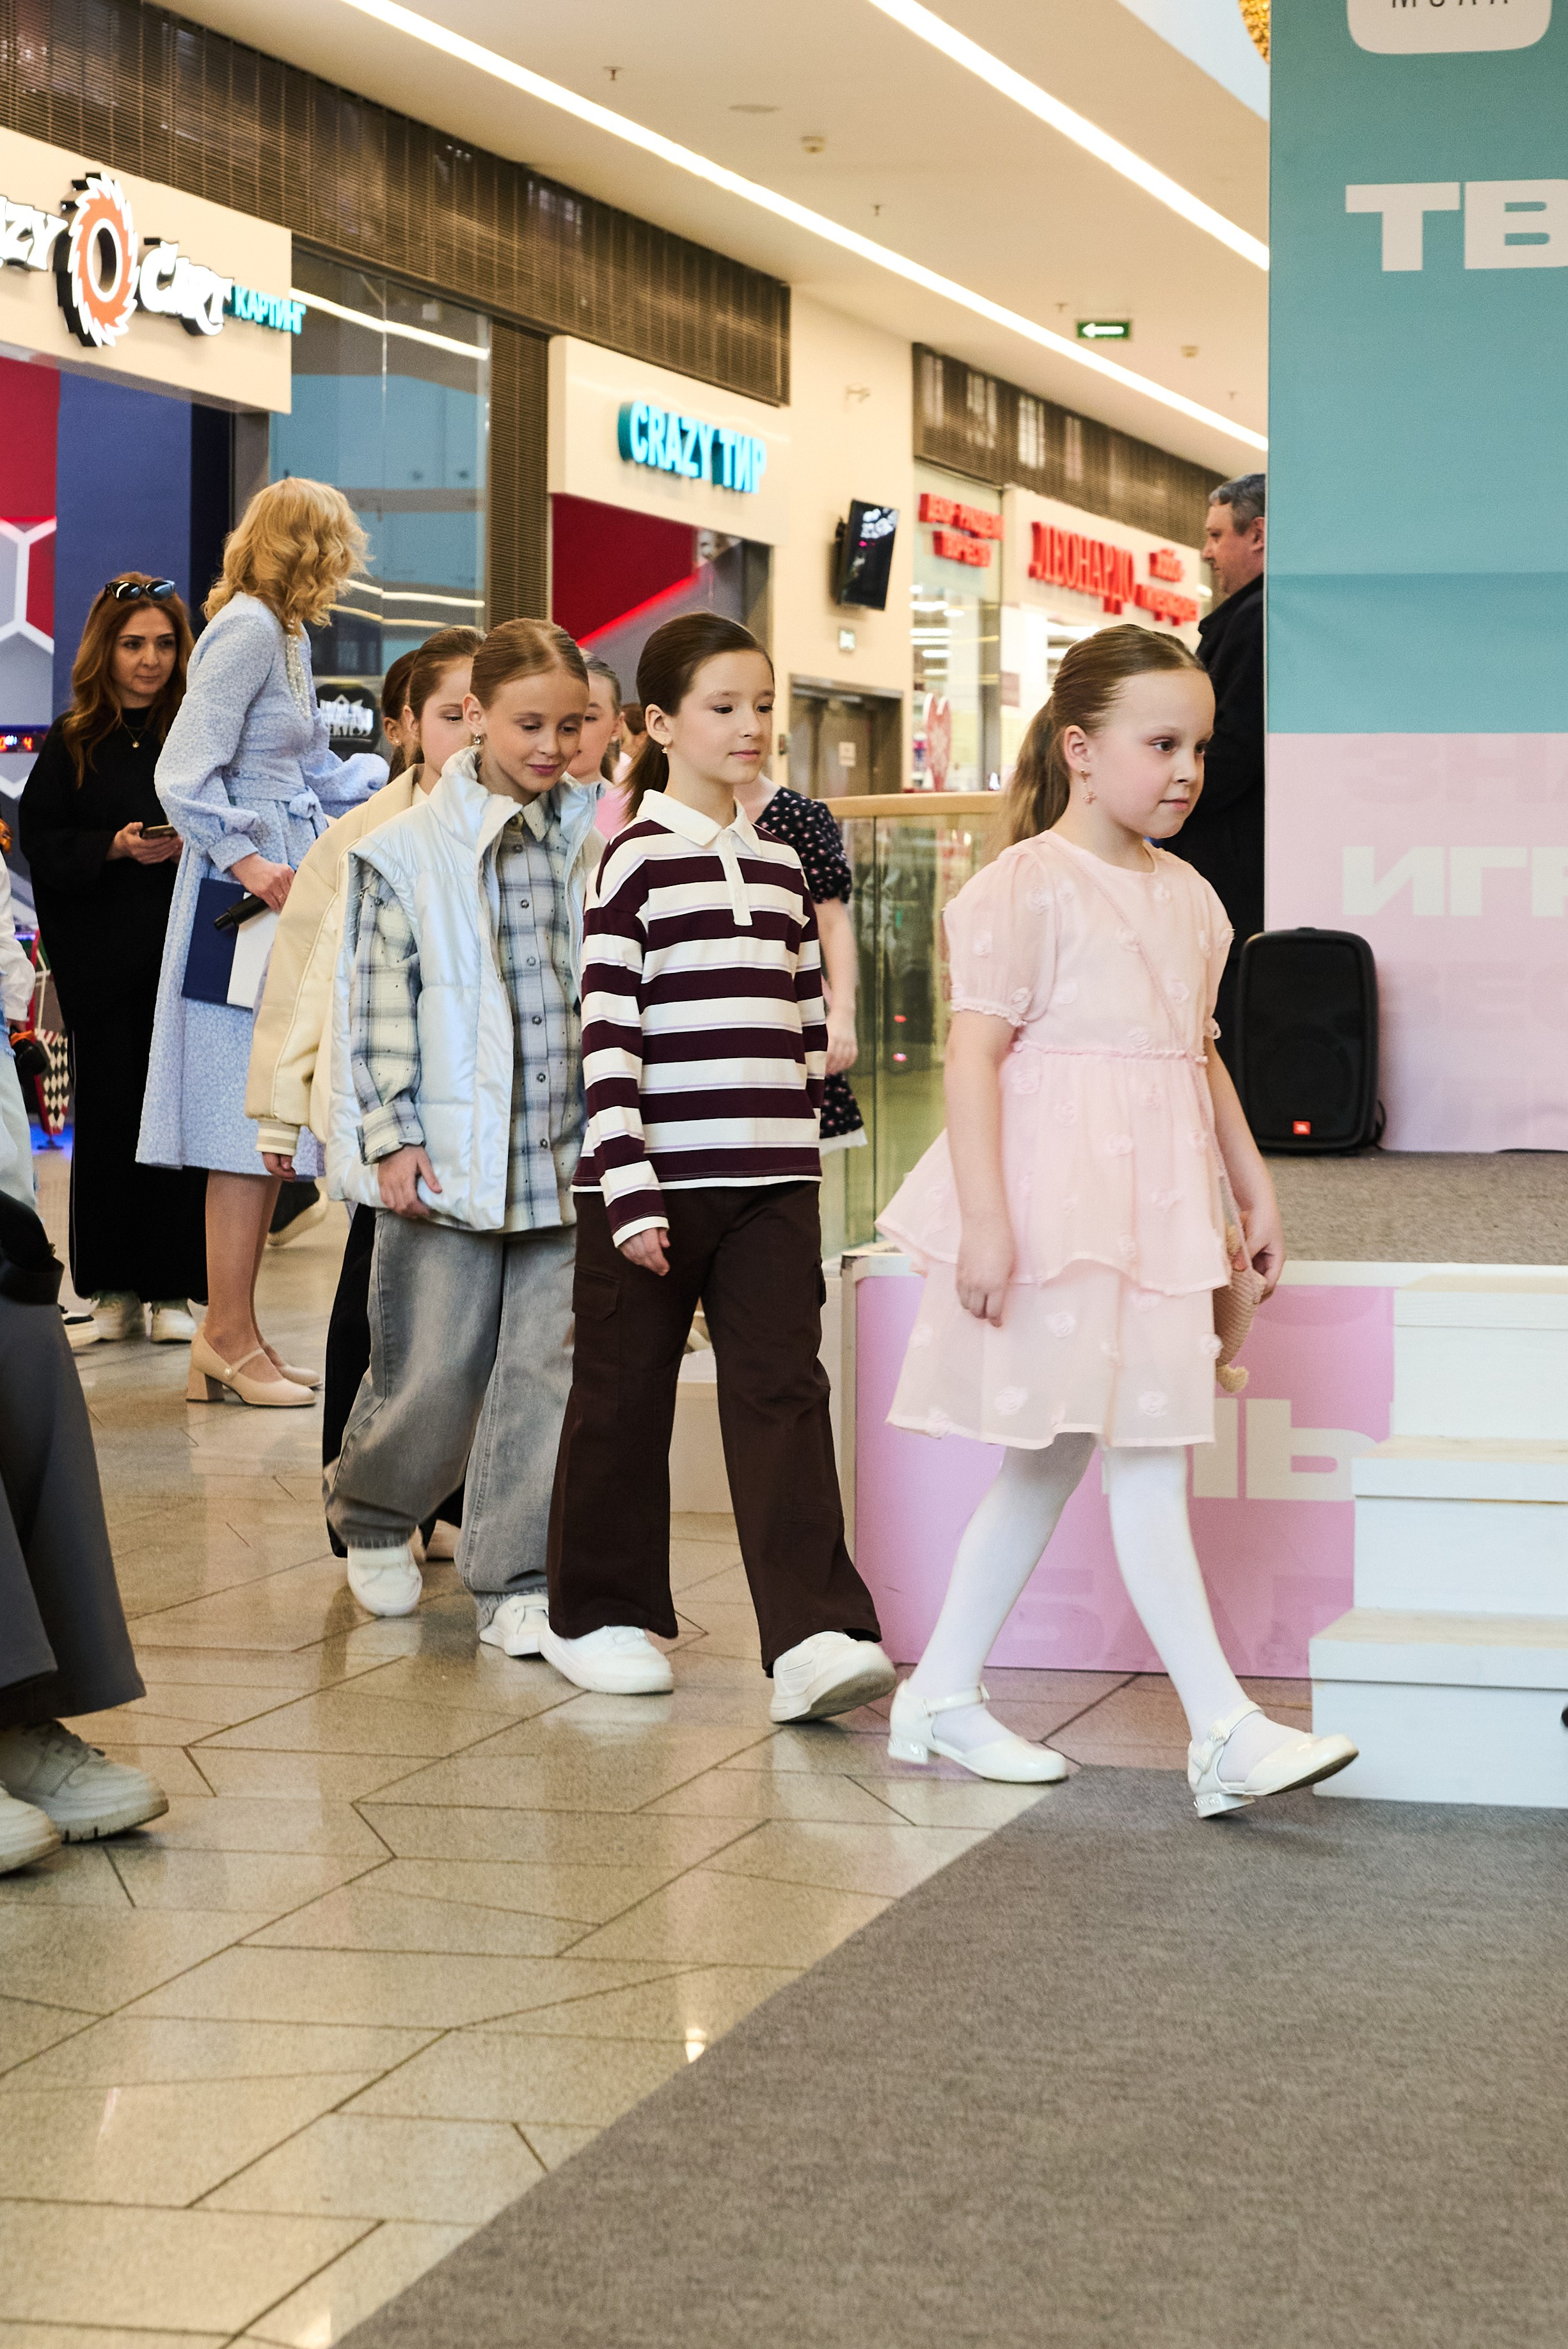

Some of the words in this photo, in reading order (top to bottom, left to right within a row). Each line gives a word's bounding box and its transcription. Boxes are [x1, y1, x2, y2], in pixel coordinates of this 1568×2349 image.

[0, 193, 68, 271] ZY
[234, 285, 306, 335] КАРТИНГ
[628, 399, 715, 481] CRAZY
[718, 427, 767, 494] ТИР
[1030, 523, 1135, 612] ЛЕОНАРДО
